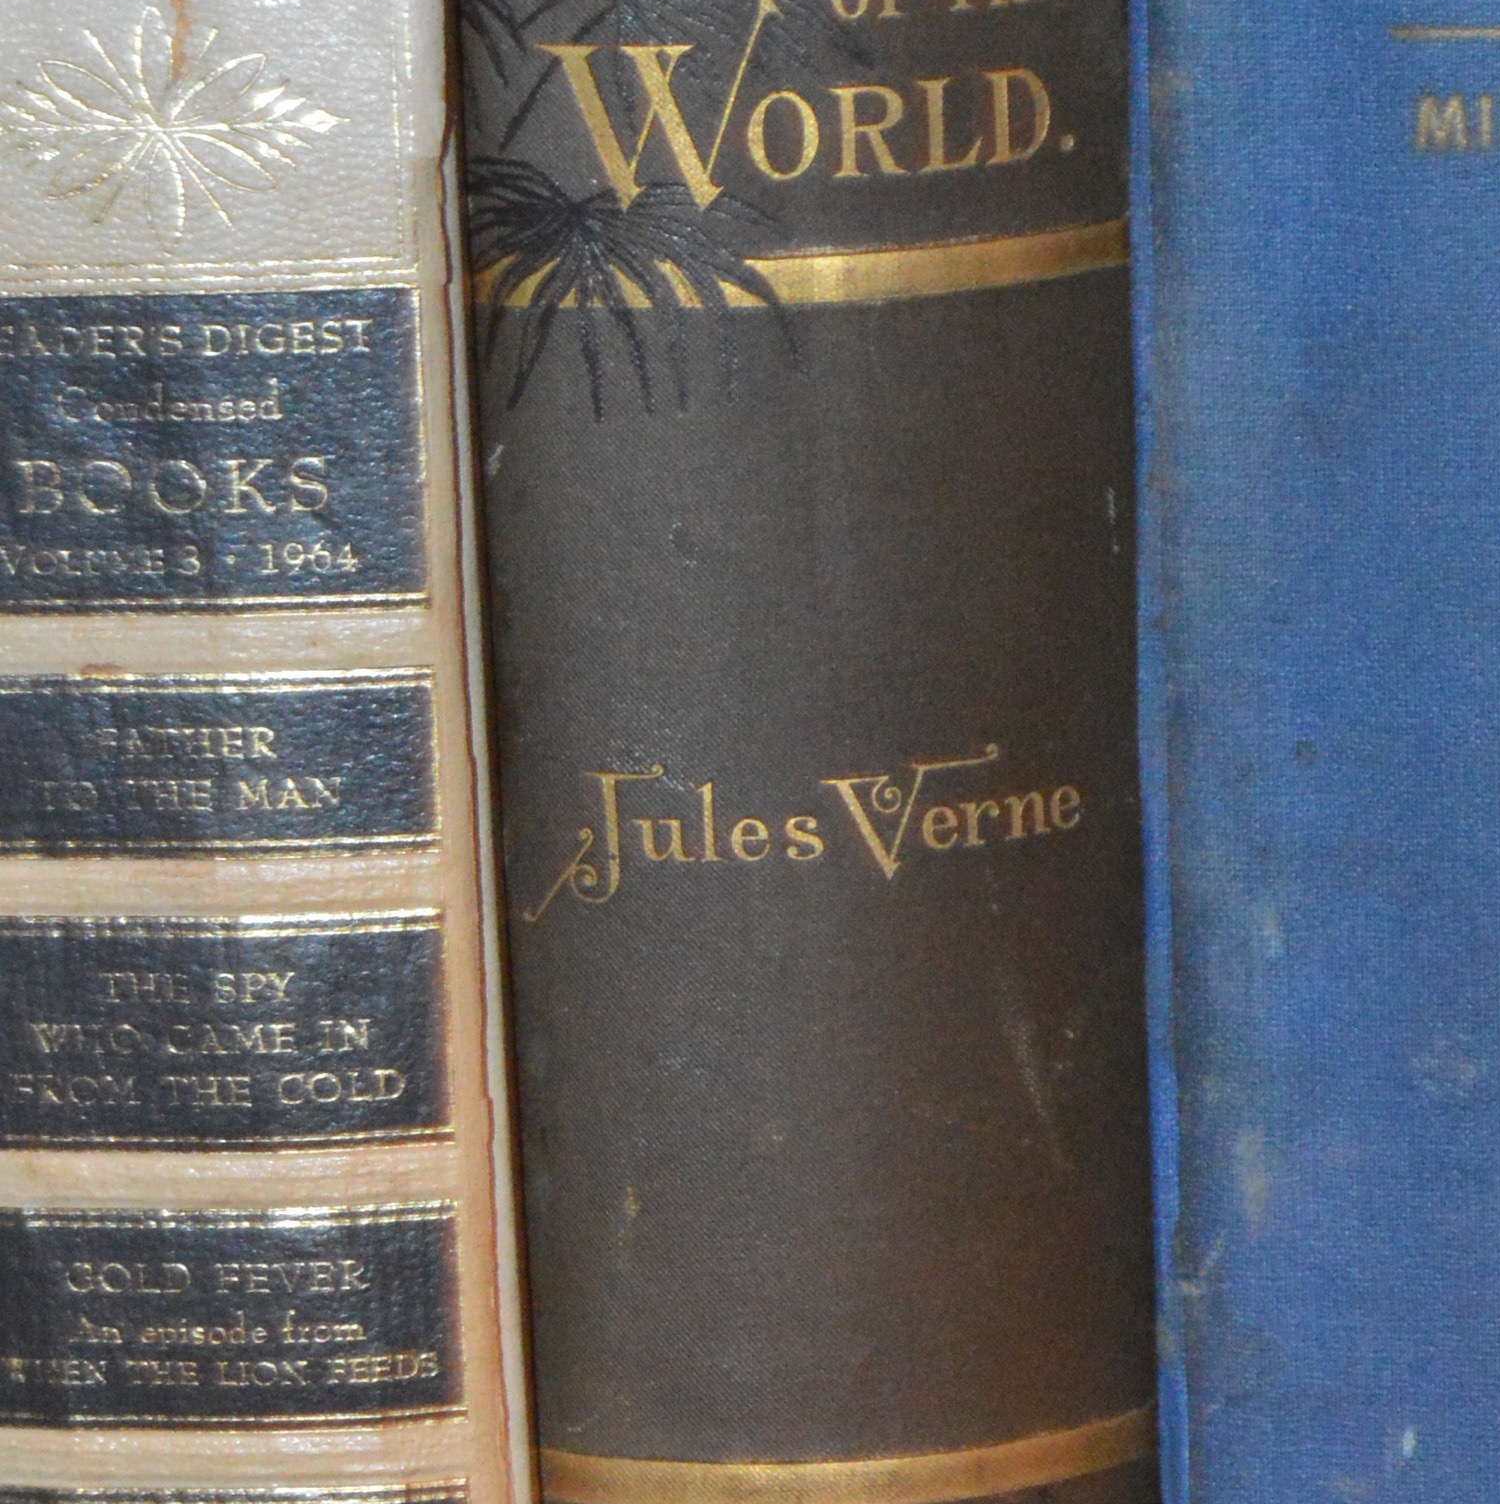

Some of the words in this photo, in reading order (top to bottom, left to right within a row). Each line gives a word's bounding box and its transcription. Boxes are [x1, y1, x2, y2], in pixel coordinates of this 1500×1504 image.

[201, 317, 374, 356] DIGEST
[56, 378, 283, 422] Condensed
[15, 456, 330, 514] BOOKS
[178, 545, 201, 576] 3
[259, 541, 360, 573] 1964
[100, 726, 277, 760] FATHER
[42, 780, 98, 810] TO
[126, 779, 213, 811] THE
[235, 776, 344, 810] MAN
[523, 763, 825, 922] Jules
[820, 743, 1080, 880] Verne
[100, 971, 188, 1004] THE
[214, 970, 295, 1003] SPY
[30, 1023, 148, 1054] WHO
[168, 1022, 296, 1054] CAME
[320, 1019, 372, 1051] IN
[10, 1074, 136, 1104] FROM
[160, 1074, 252, 1106] THE
[276, 1069, 406, 1103] COLD
[67, 1262, 191, 1293] GOLD
[215, 1260, 370, 1293] FEVER
[141, 1310, 268, 1349] episode
[283, 1309, 367, 1344] from
[126, 1360, 200, 1386] THE
[217, 1359, 309, 1387] LION
[327, 1351, 439, 1384] FEEDS
